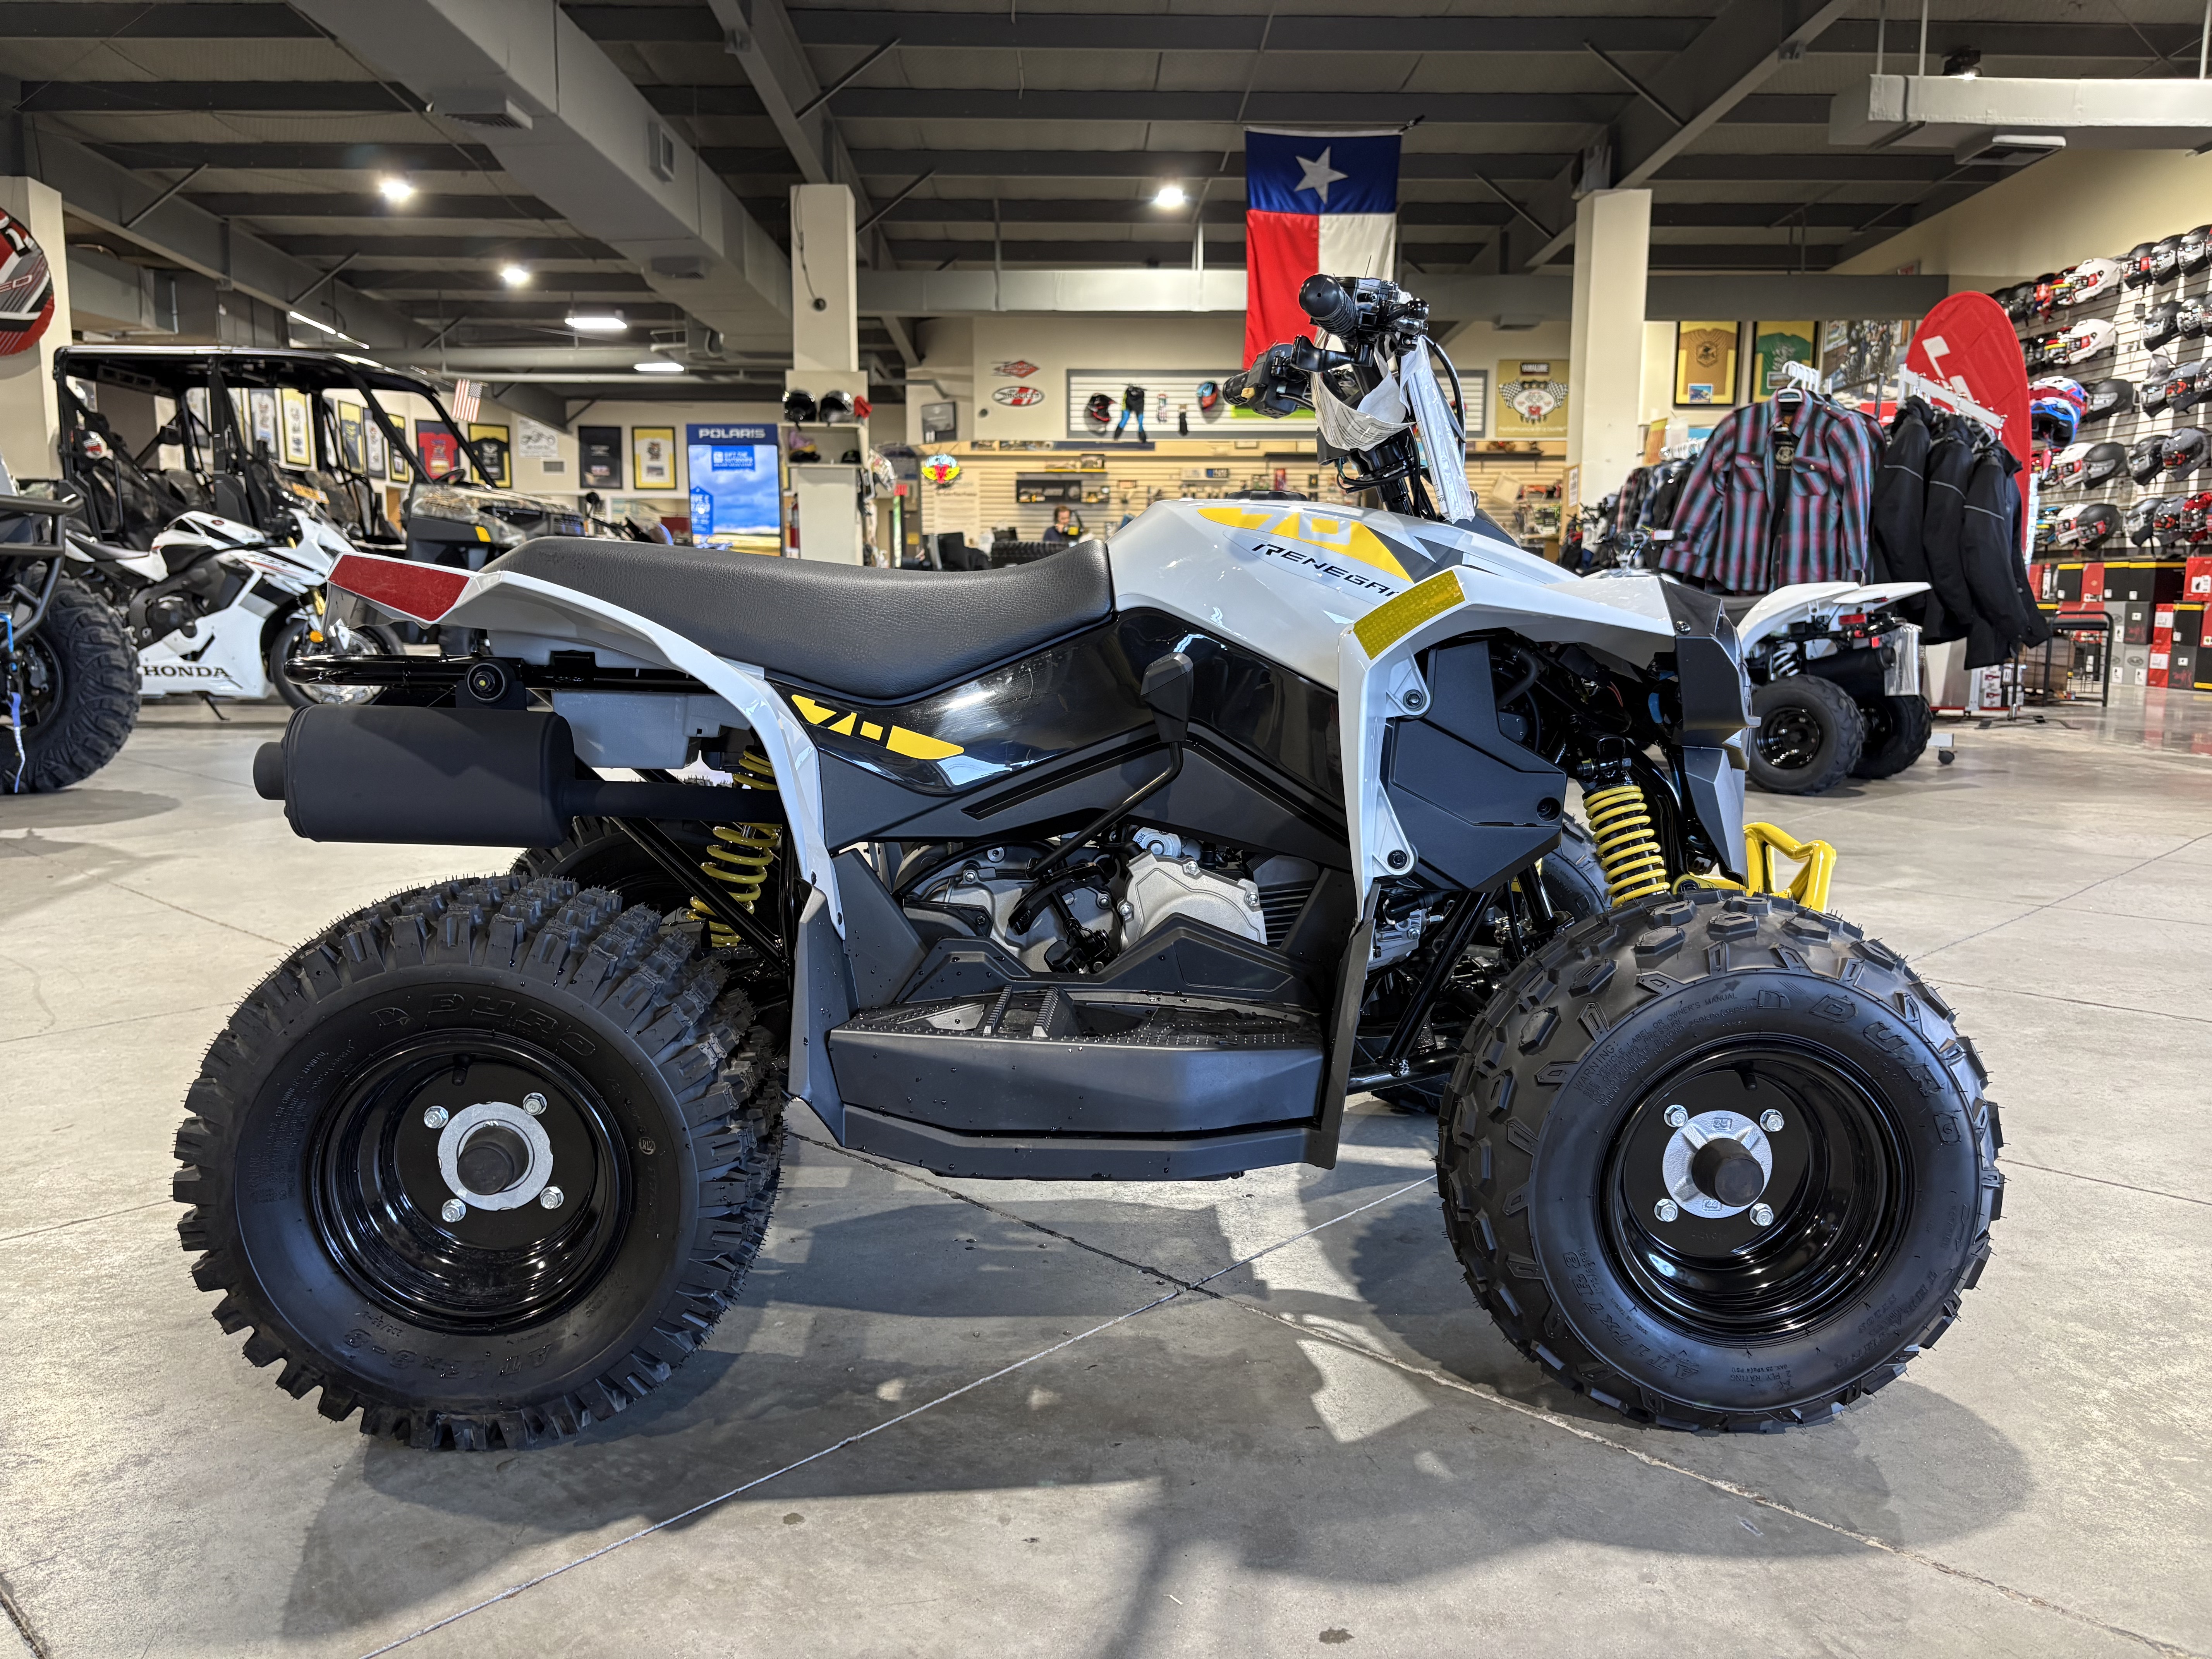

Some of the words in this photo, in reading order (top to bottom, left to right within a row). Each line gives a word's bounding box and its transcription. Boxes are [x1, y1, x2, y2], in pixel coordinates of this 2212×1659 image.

[699, 428, 766, 439] POLARIS
[142, 666, 233, 678] HONDA
[1596, 1048, 1626, 1077] VEHICLE
[1627, 1029, 1650, 1047] LABEL
[1653, 1019, 1664, 1029] OR
[1667, 1002, 1700, 1020] OWNER'S
[1705, 992, 1738, 1006] MANUAL
[1654, 1025, 1685, 1046] BEYOND
[1573, 1041, 1618, 1091] WARNING:
[1602, 1046, 1640, 1082] OPERATING
[1729, 1374, 1760, 1382] RATING
[1766, 1372, 1781, 1381] PLY
